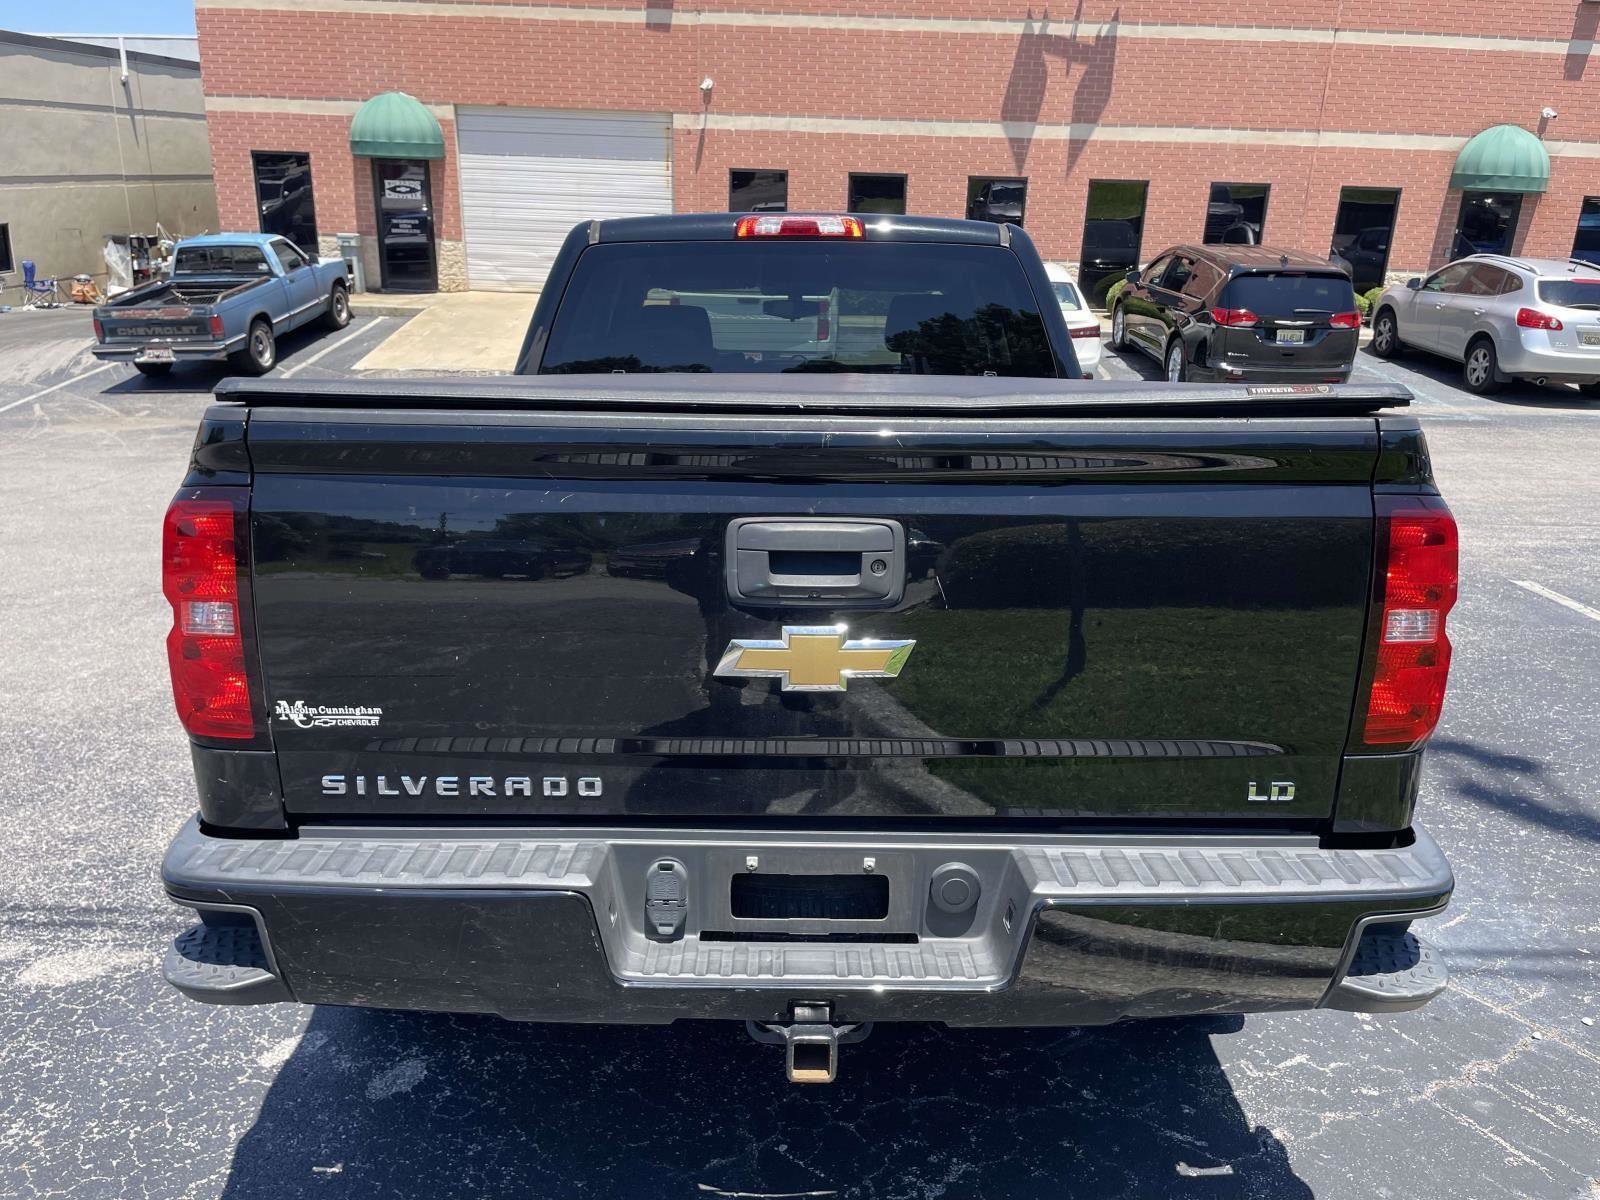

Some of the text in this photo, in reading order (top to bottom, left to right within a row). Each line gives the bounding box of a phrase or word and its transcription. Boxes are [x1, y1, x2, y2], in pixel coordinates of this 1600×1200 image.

[116, 326, 198, 335] CHEVROLET
[275, 705, 383, 716] Malcolm Cunningham
[321, 775, 603, 797] SILVERADO
[1247, 781, 1296, 801] LD
